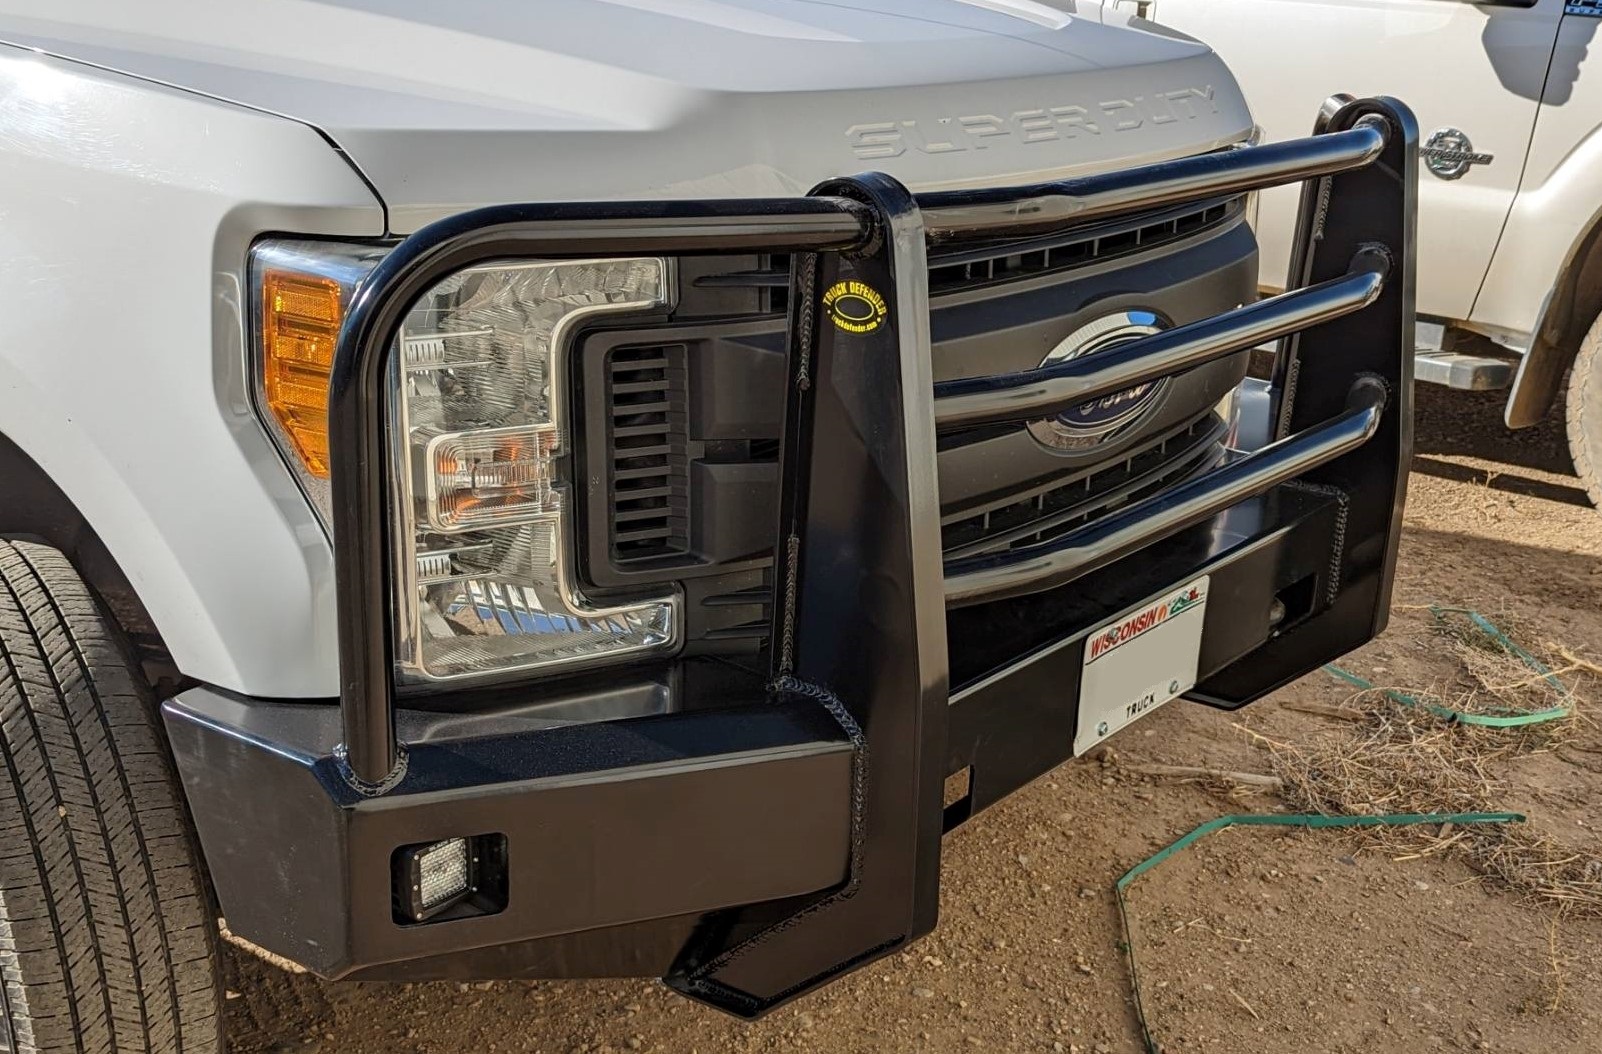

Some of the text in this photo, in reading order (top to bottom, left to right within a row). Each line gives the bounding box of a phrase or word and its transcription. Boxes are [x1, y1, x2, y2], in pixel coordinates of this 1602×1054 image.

[845, 84, 1215, 160] SUPER DUTY
[822, 281, 887, 315] TRUCK DEFENDER
[1090, 606, 1158, 659] WISCONSIN
[1126, 692, 1155, 719] TRUCK
